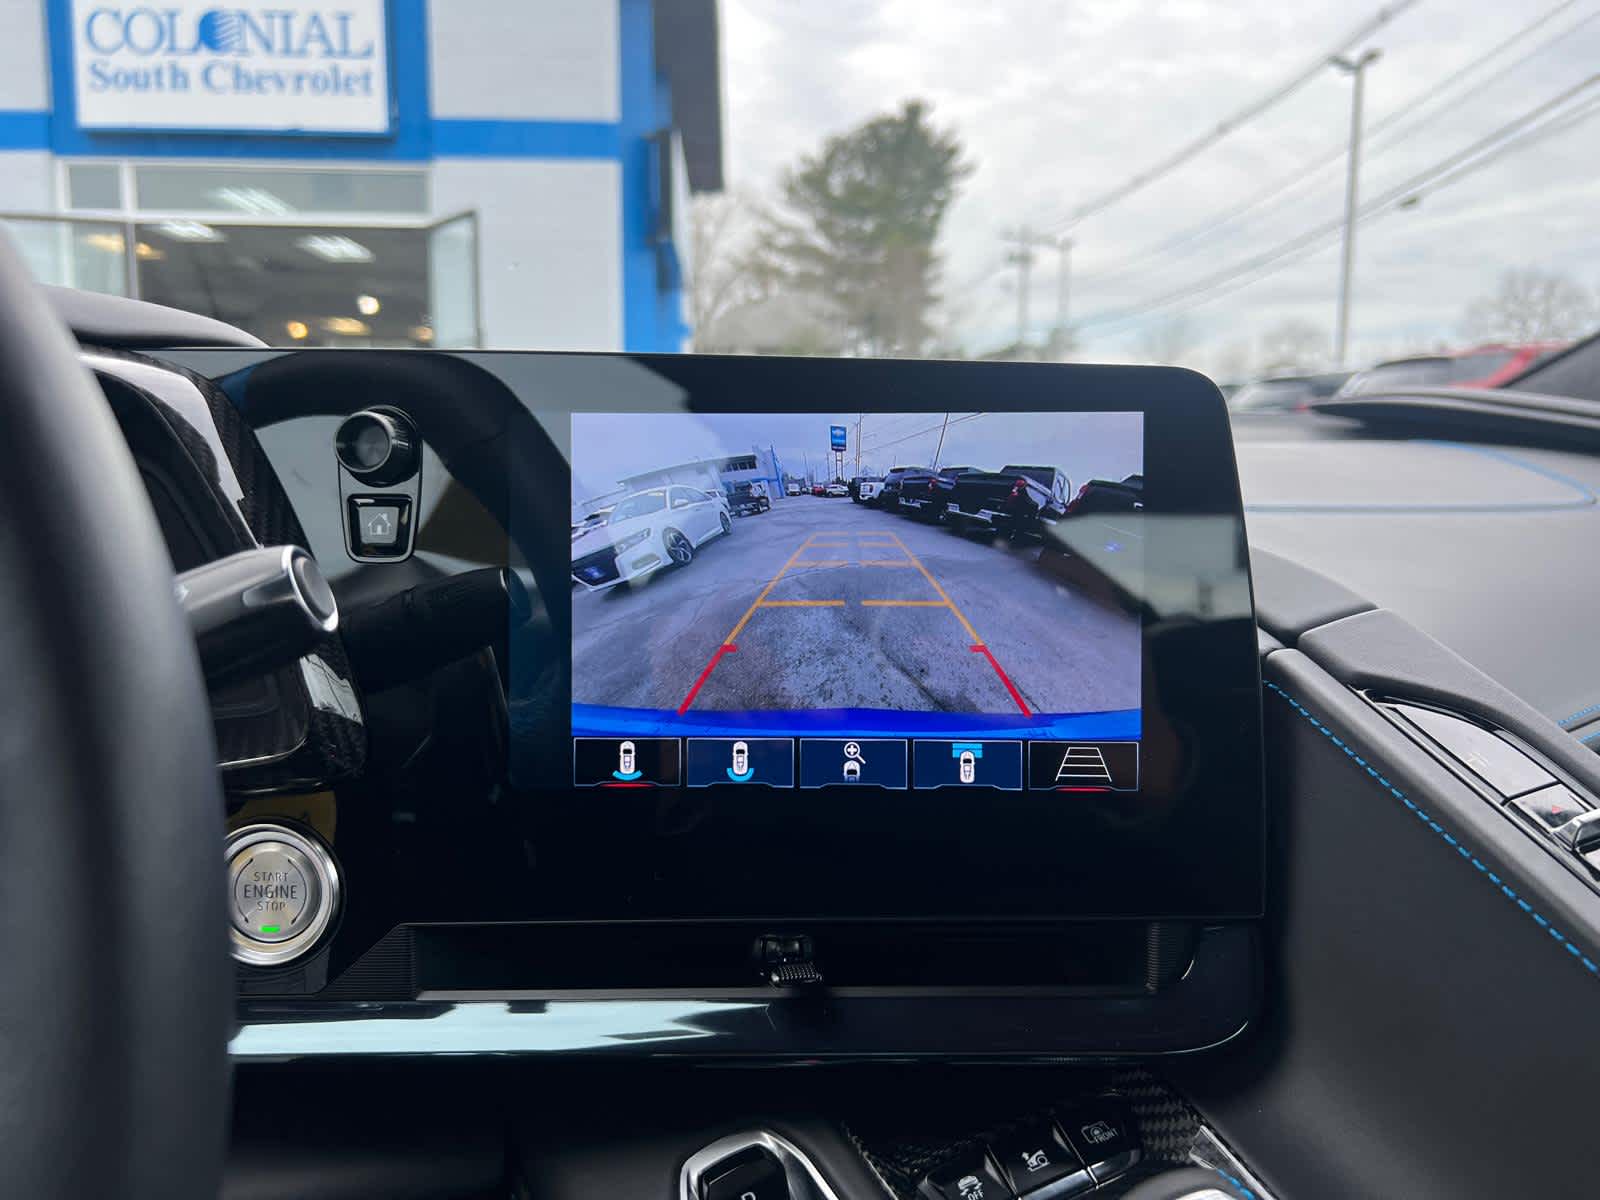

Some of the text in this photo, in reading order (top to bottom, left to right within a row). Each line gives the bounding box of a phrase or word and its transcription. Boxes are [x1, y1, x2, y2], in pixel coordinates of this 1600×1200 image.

[89, 60, 374, 95] South Chevrolet
[253, 871, 289, 881] START
[243, 884, 298, 899] ENGINE
[257, 901, 286, 911] STOP
[1094, 1128, 1119, 1143] FRONT
[967, 1189, 984, 1200] OFF
